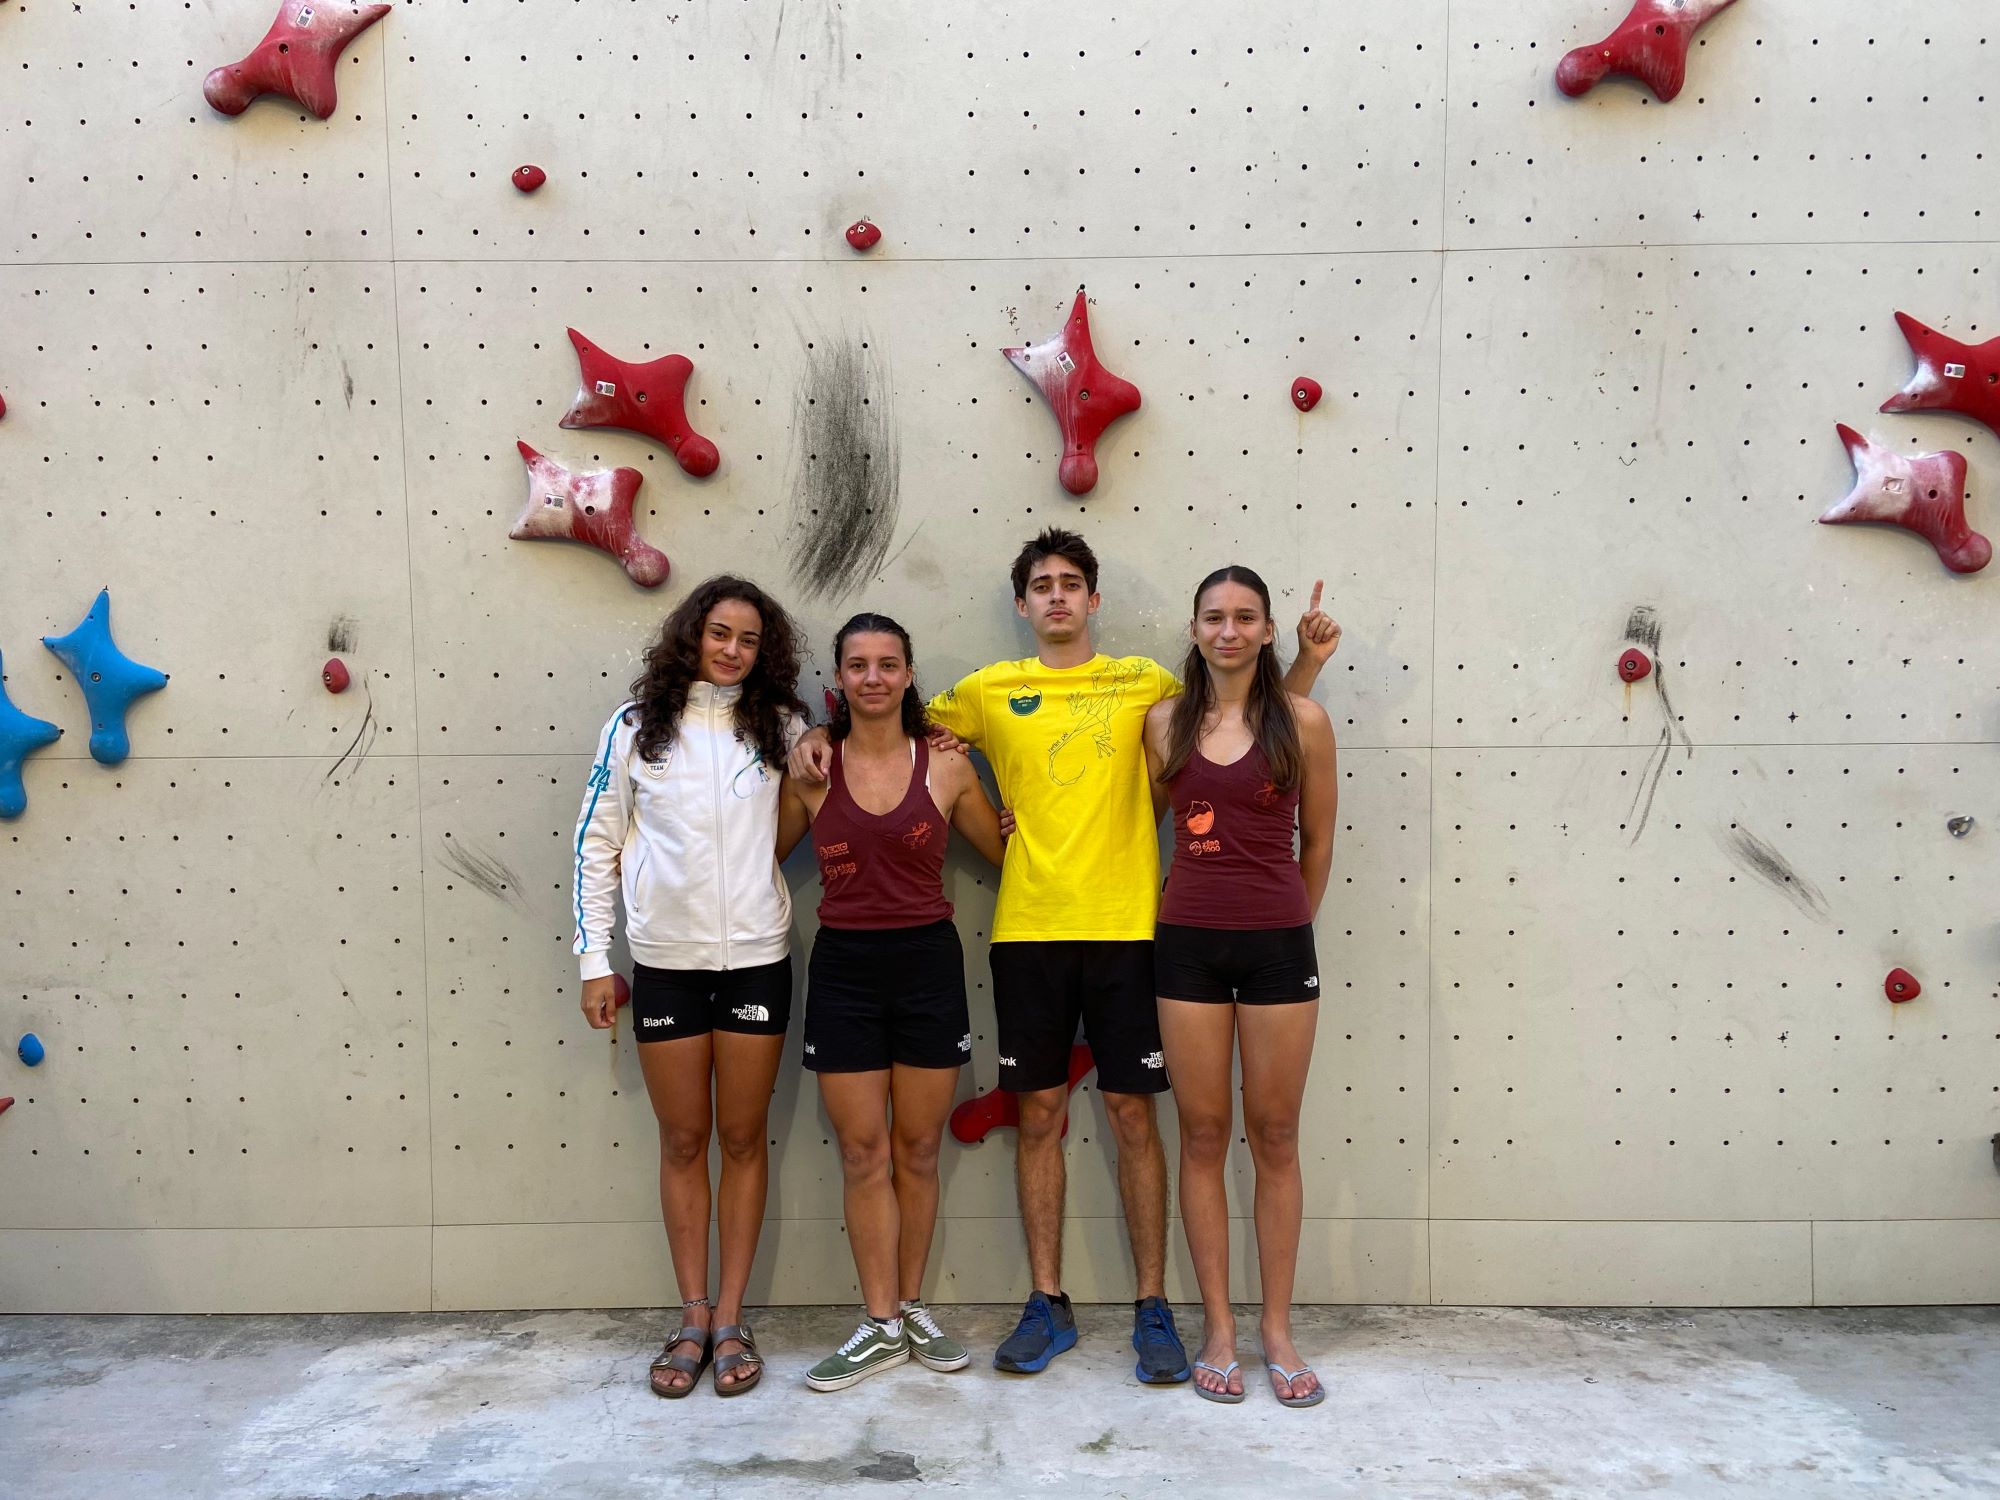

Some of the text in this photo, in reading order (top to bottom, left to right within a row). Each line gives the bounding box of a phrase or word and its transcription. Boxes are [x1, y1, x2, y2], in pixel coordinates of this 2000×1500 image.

[587, 764, 611, 792] 74
[732, 1007, 758, 1017] NORTH
[643, 1015, 675, 1027] Blank
